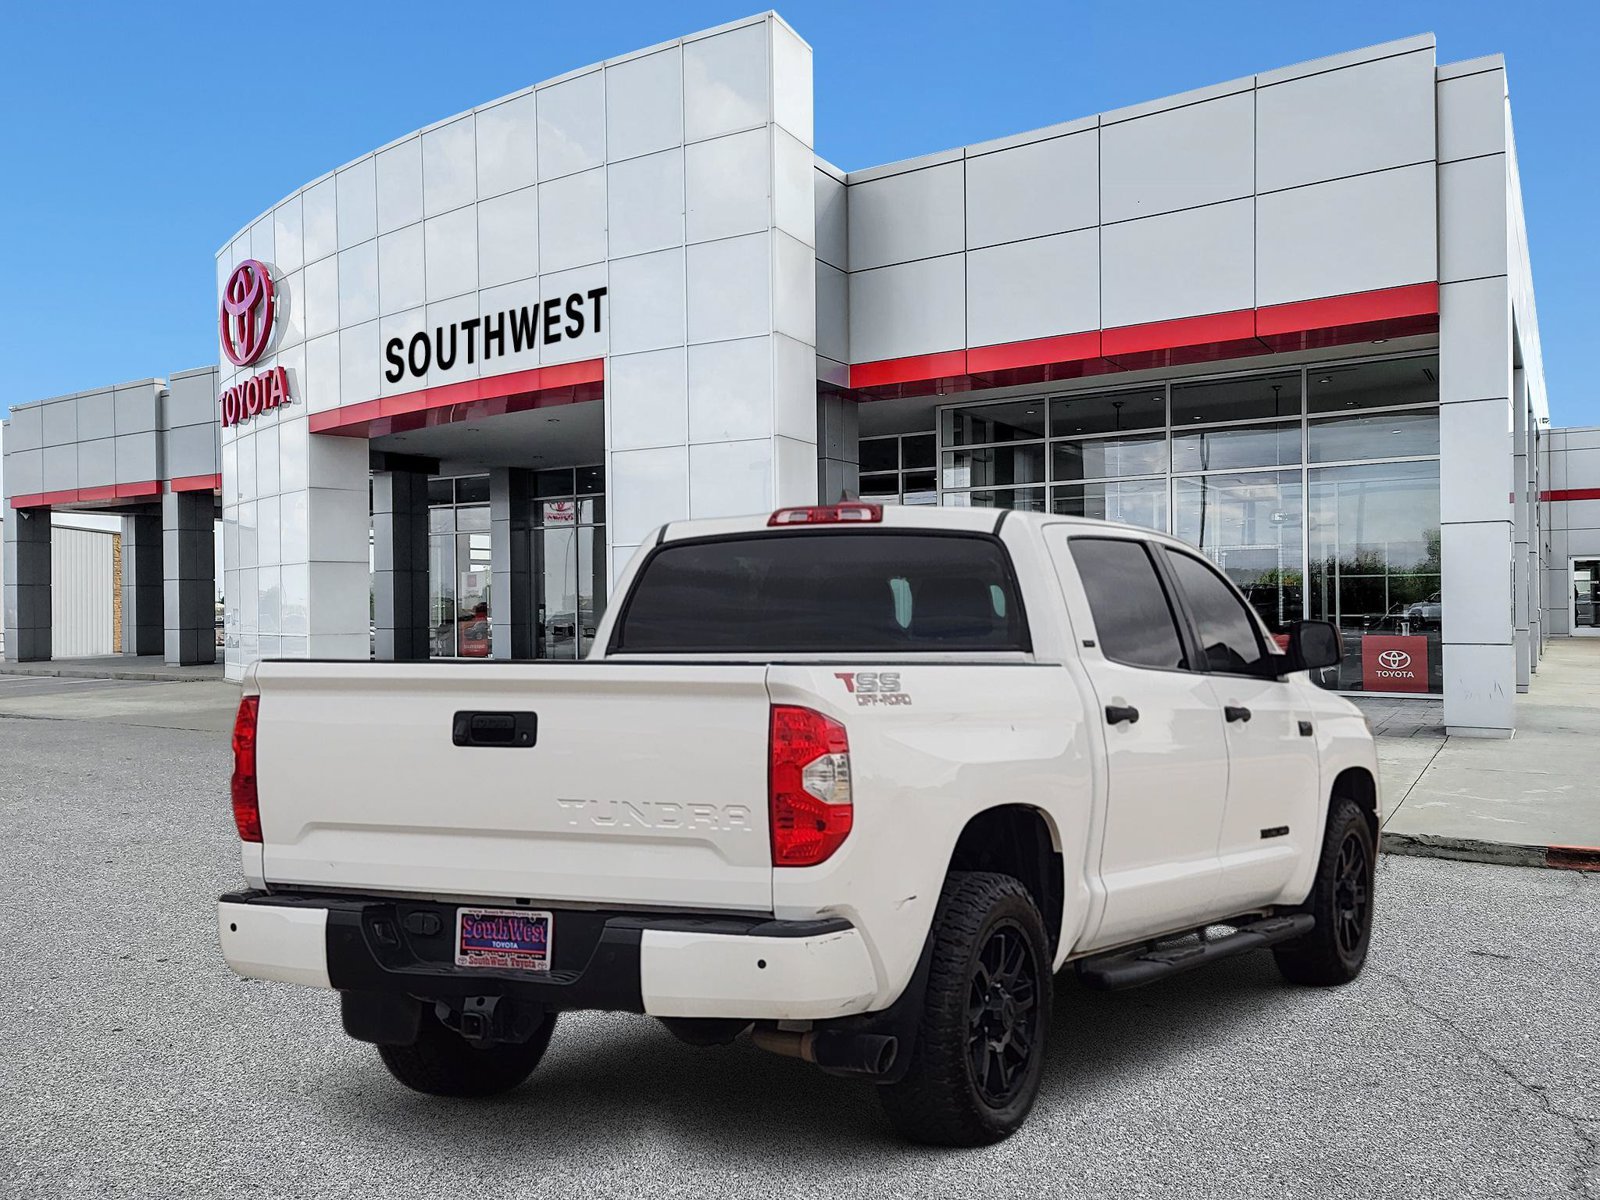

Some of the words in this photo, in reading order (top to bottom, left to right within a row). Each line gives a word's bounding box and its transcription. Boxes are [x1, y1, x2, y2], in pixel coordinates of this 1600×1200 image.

[385, 286, 607, 384] SOUTHWEST
[218, 366, 290, 427] TOYOTA
[834, 672, 901, 693] TSS
[1376, 670, 1414, 678] TOYOTA
[557, 798, 752, 831] TUNDRA
[492, 941, 518, 949] TOYOTA
